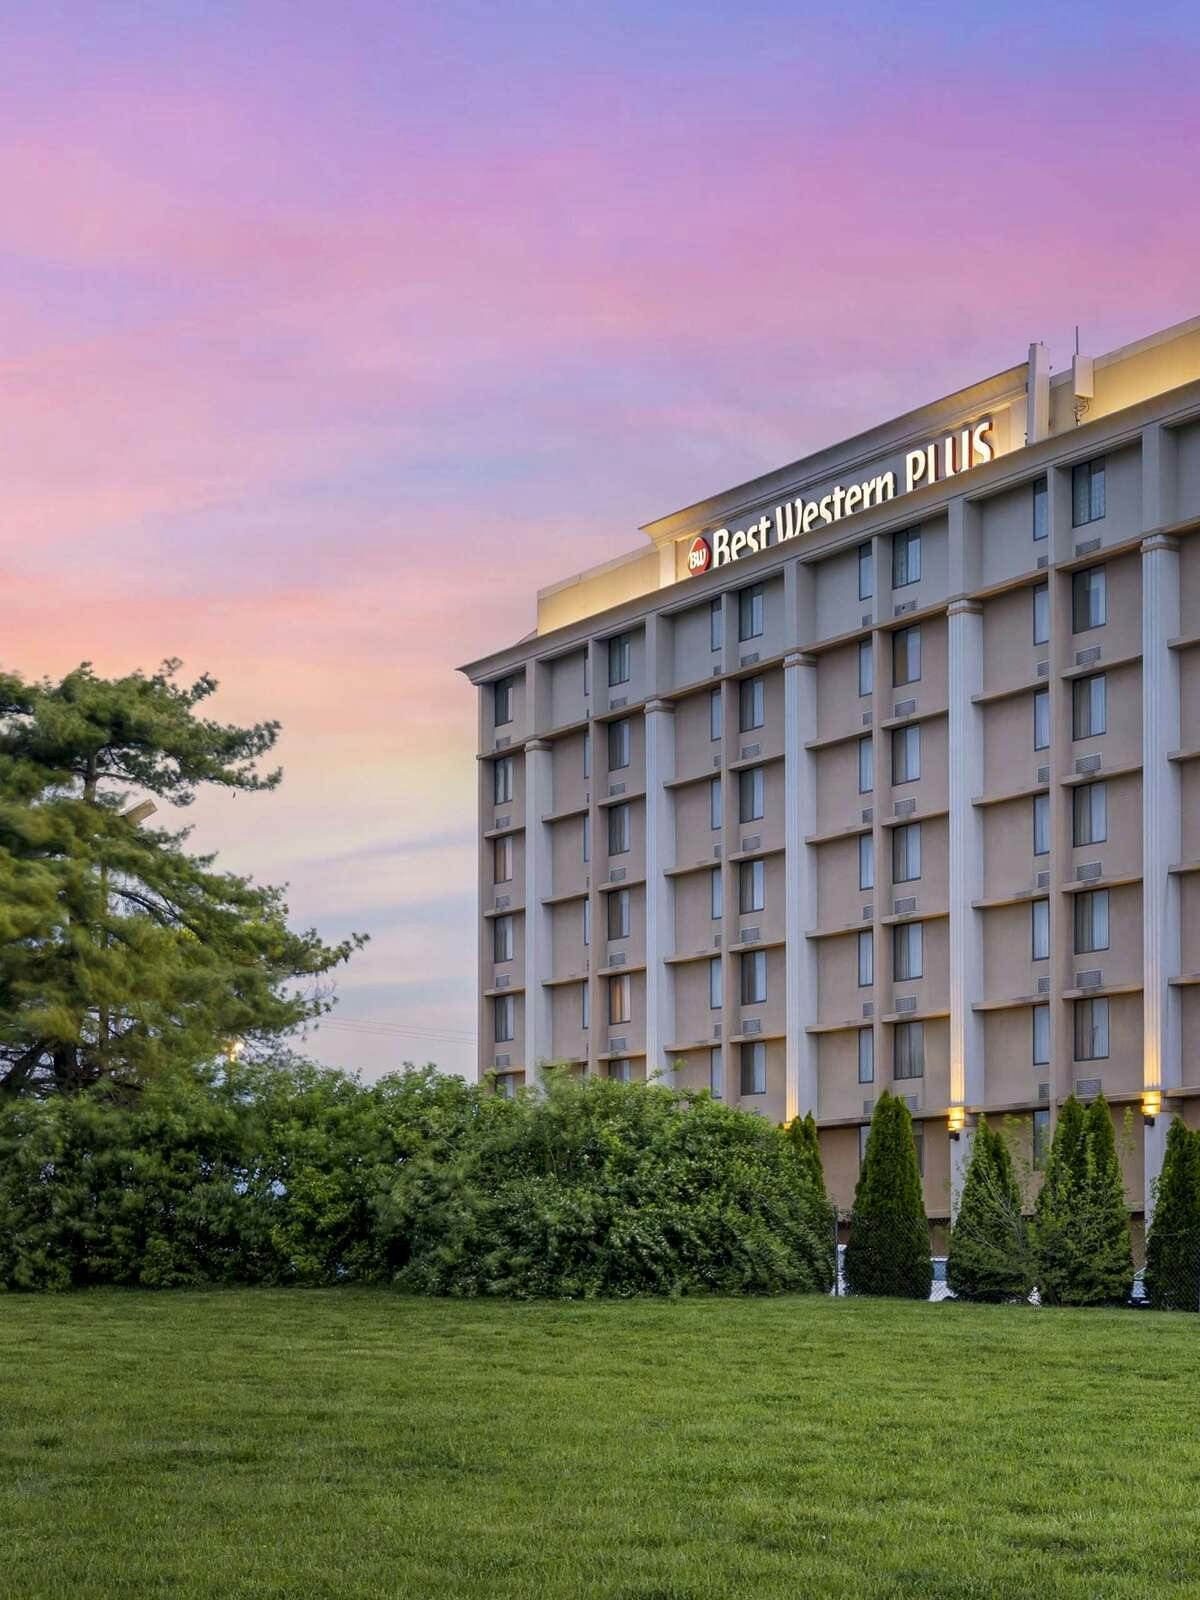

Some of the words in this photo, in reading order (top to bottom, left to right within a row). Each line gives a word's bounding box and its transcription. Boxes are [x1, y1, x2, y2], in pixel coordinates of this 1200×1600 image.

[690, 548, 706, 570] BW
[713, 515, 771, 568] Best
[775, 471, 894, 543] Western
